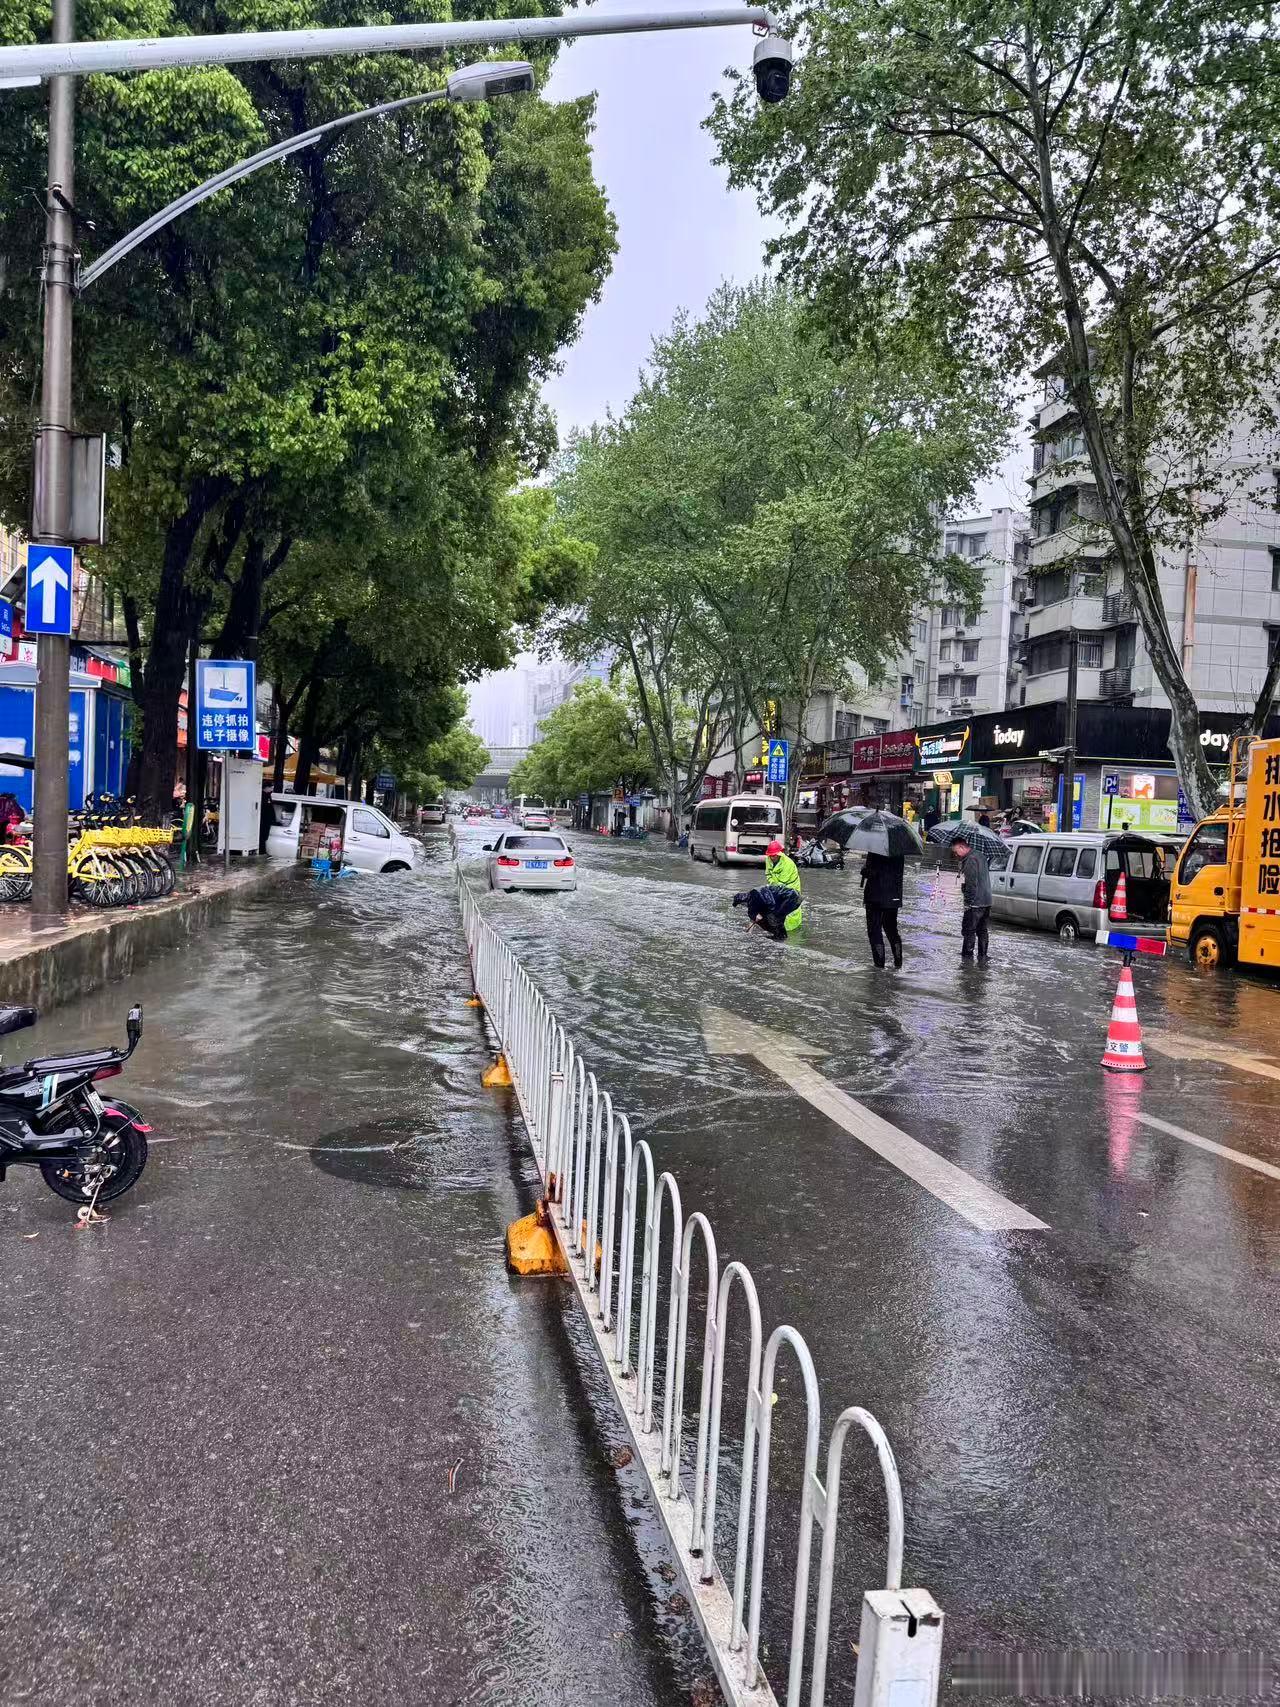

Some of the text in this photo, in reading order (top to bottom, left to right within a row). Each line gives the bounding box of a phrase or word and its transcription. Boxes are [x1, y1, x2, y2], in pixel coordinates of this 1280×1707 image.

[202, 714, 248, 726] 违停抓拍
[203, 729, 249, 741] 电子摄像
[994, 725, 1024, 748] Today
[1109, 1042, 1128, 1053] 交警
